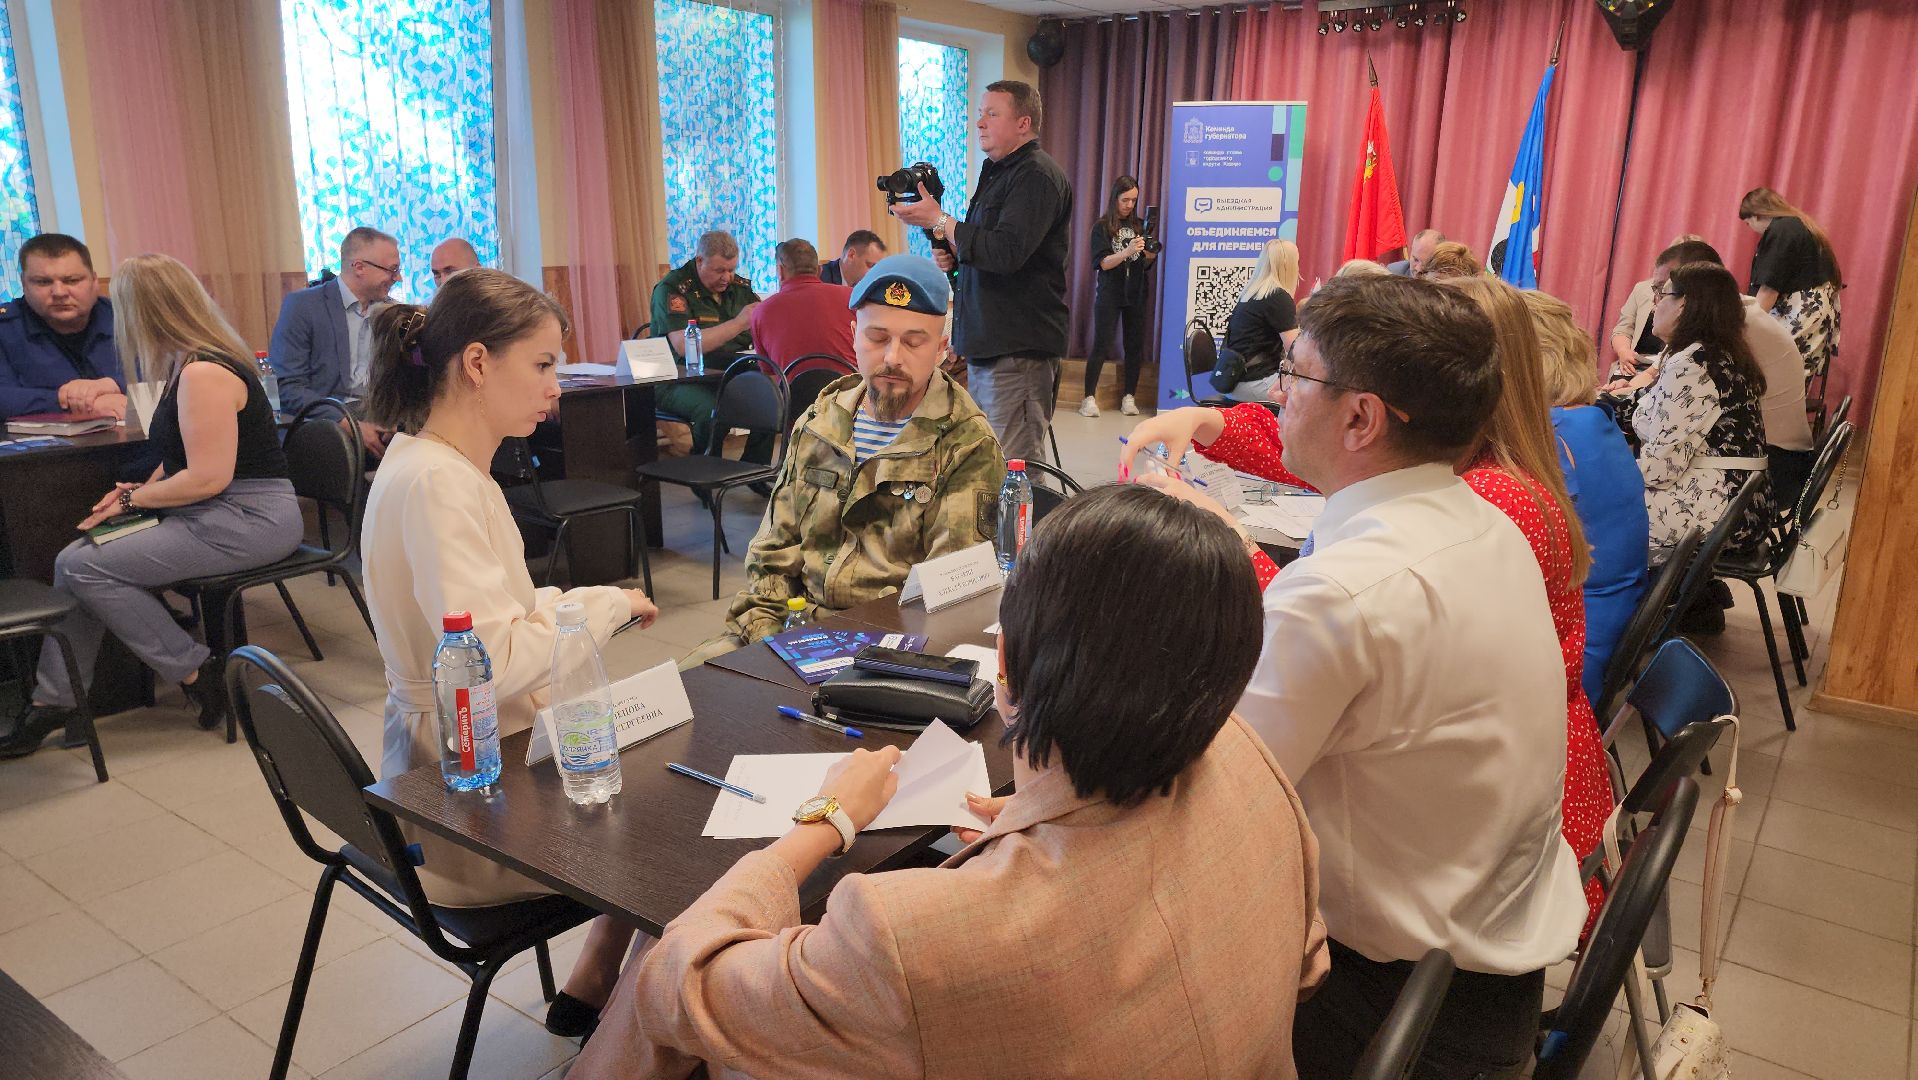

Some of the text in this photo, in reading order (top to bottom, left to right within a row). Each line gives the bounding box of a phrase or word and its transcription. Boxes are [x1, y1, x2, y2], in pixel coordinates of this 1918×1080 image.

[1205, 125, 1235, 133] Команда
[1204, 132, 1247, 141] губернатора
[1186, 227, 1277, 238] ОБЪЕДИНЯЕМСЯ
[1192, 241, 1217, 252] ДЛЯ
[615, 708, 664, 733] СЕРГЕЕВНА
